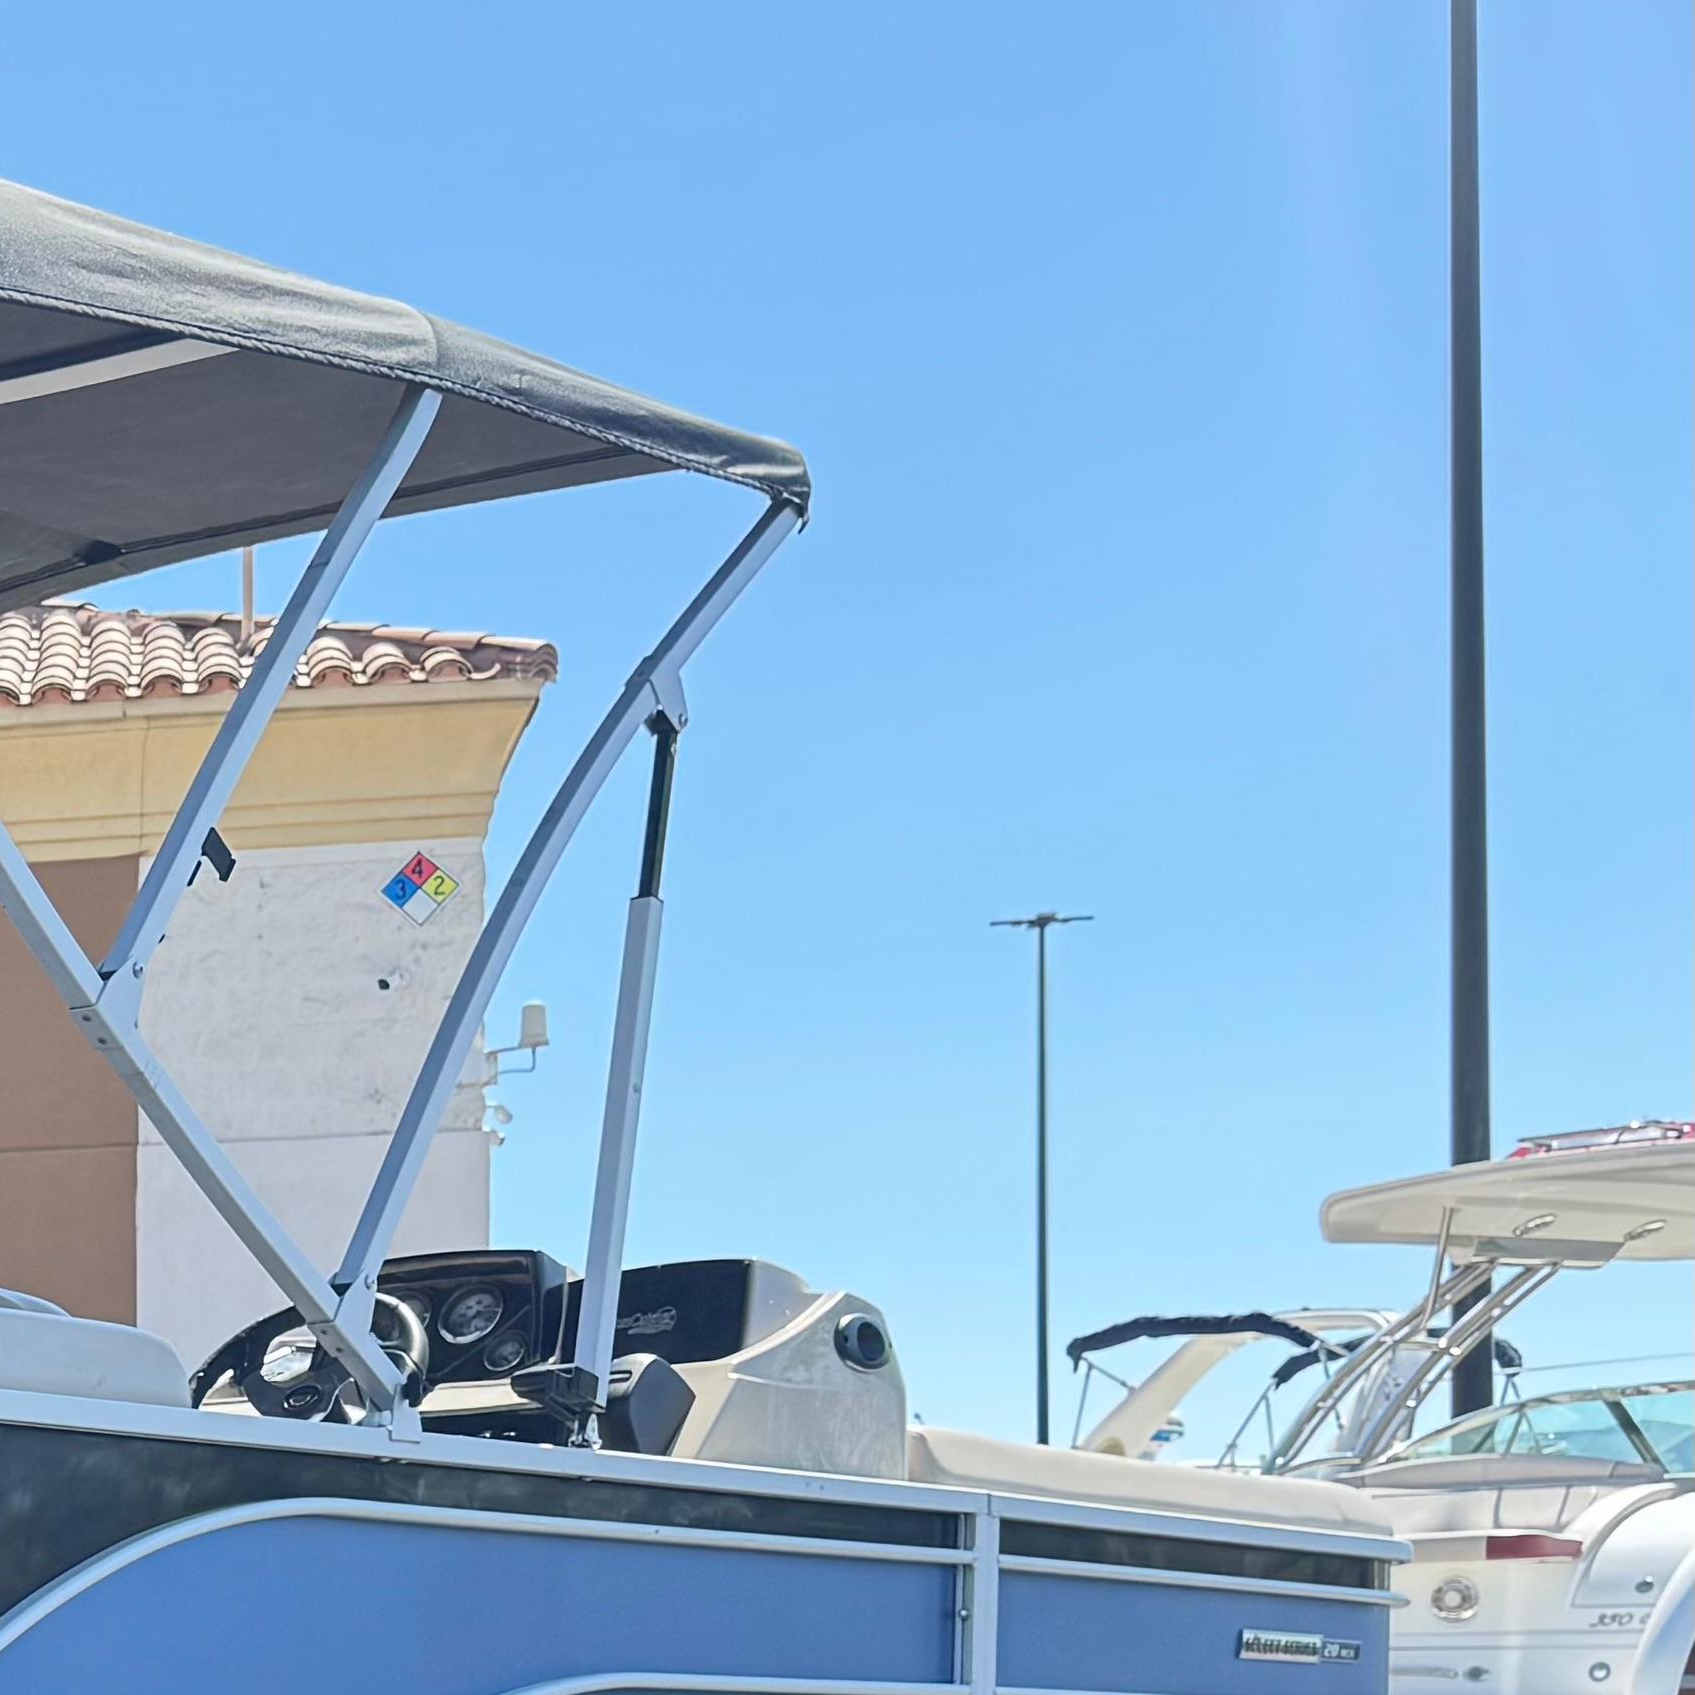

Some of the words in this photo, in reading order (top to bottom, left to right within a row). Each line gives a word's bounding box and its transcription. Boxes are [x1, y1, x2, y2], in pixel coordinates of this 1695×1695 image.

[411, 858, 423, 878] 4
[395, 880, 407, 900] 3
[433, 875, 445, 896] 2
